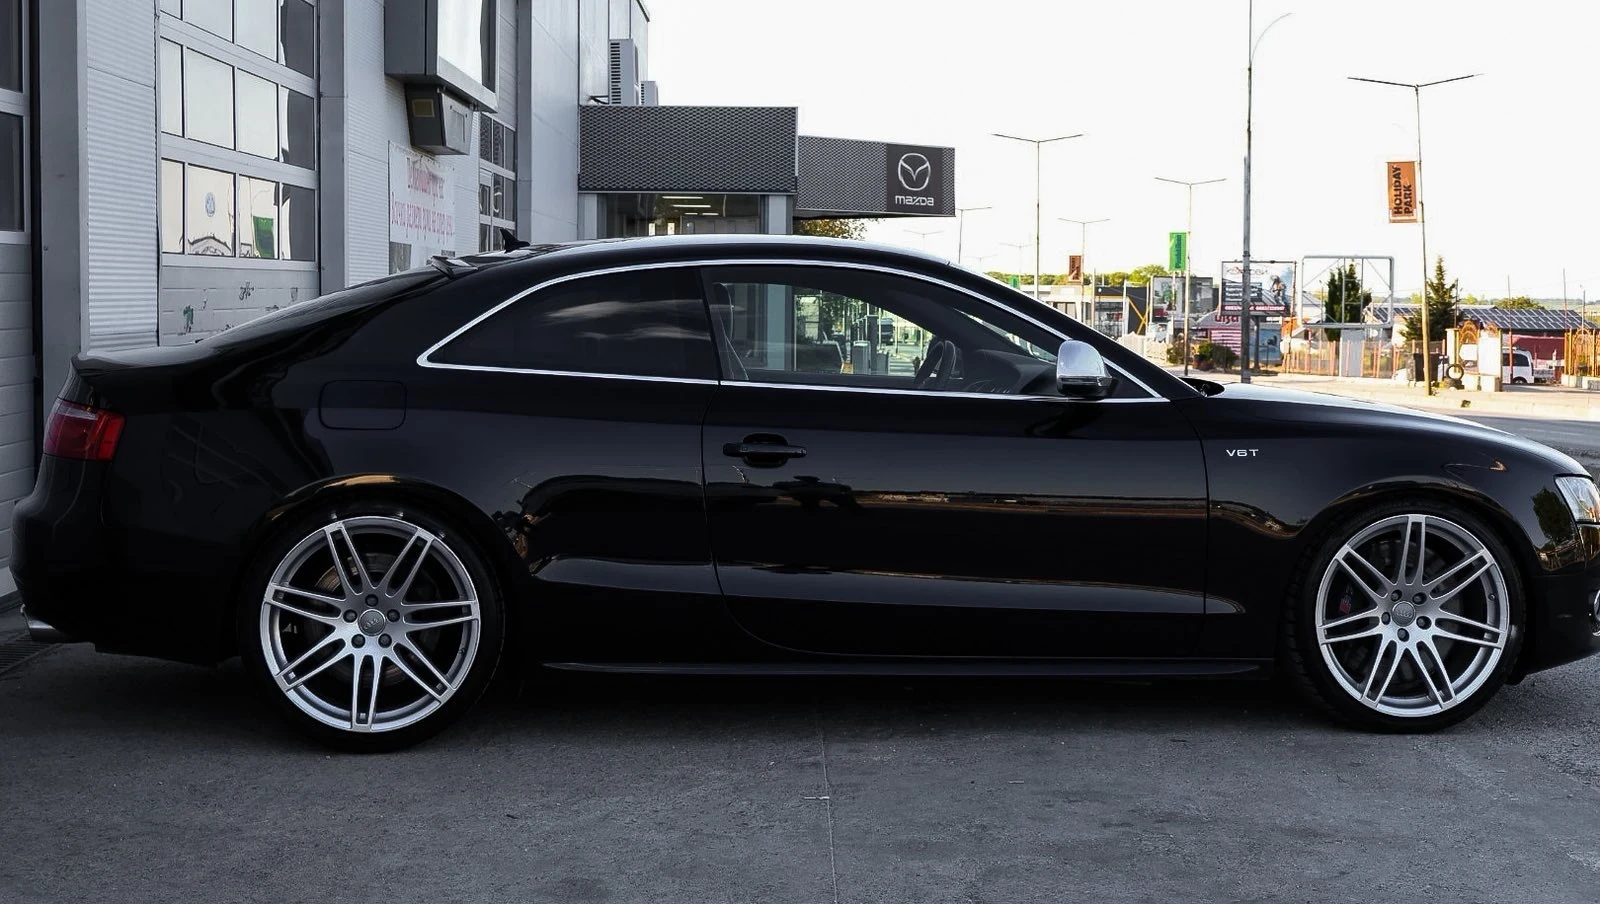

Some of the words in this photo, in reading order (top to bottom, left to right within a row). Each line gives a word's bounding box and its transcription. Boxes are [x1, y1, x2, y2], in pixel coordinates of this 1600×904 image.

[1392, 165, 1402, 214] HOLIDAY
[1403, 184, 1413, 214] PARK
[895, 195, 934, 206] mazda
[1226, 448, 1259, 457] V6T
